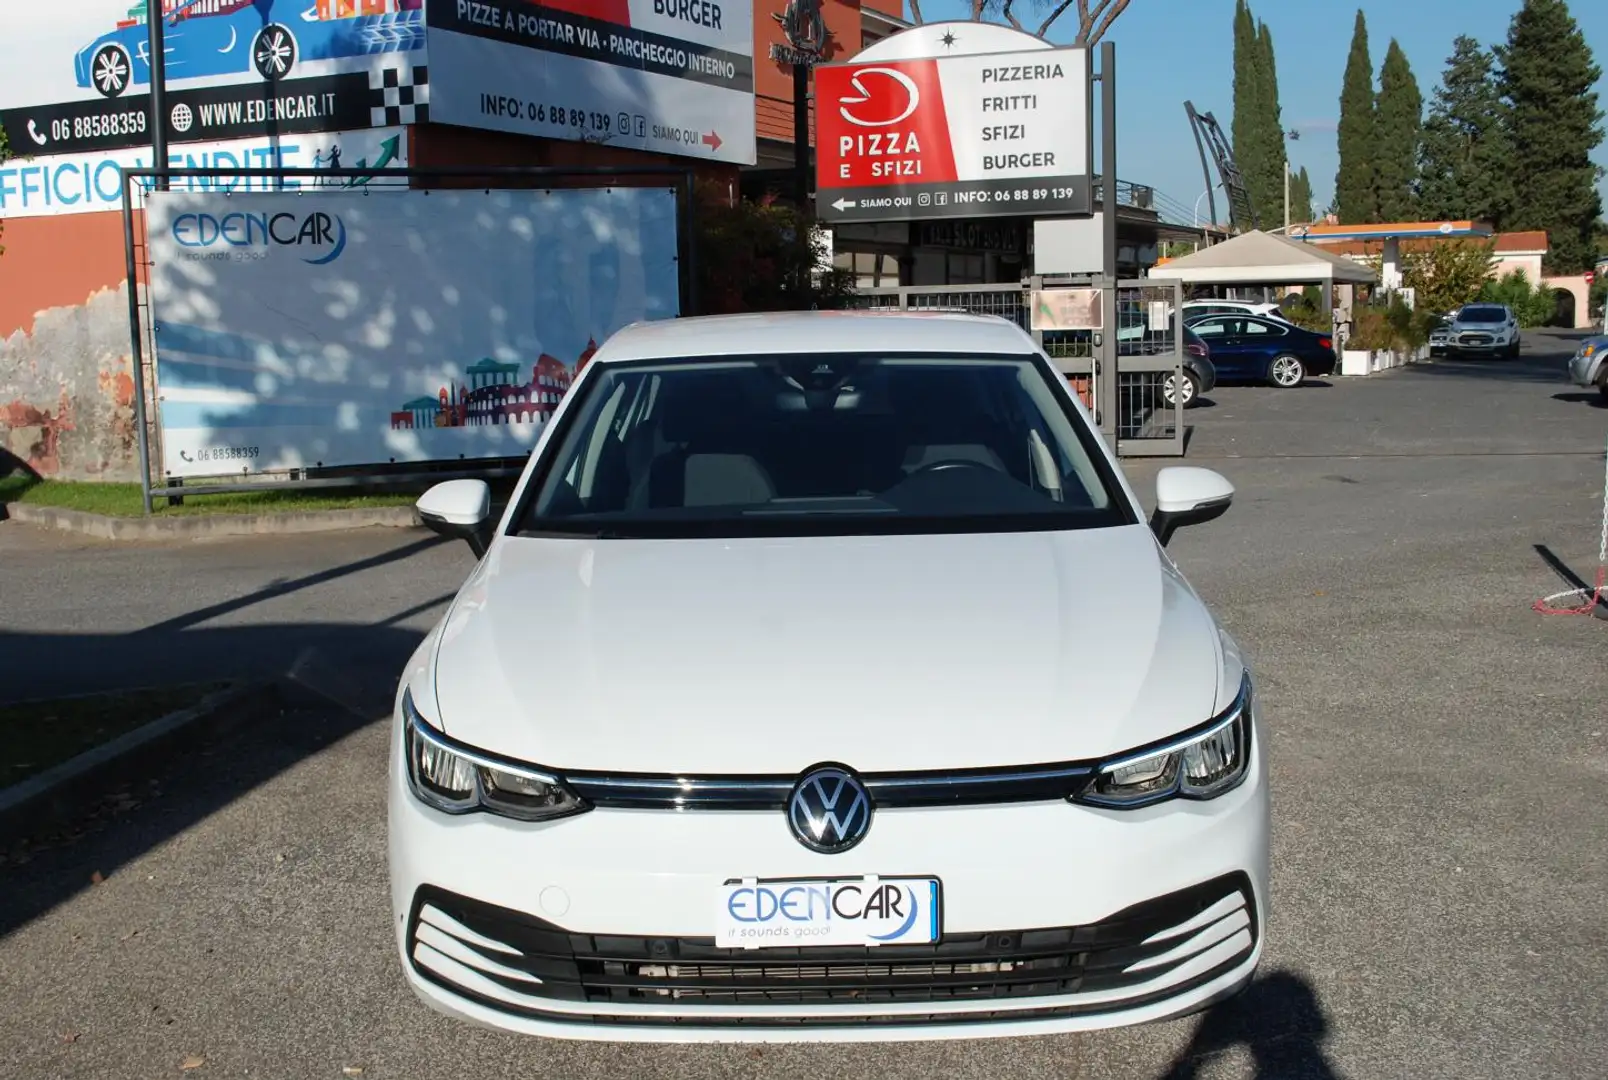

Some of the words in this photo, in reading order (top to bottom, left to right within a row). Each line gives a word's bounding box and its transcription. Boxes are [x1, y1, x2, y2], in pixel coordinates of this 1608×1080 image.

[653, 0, 722, 31] BURGER
[457, 0, 500, 28] PIZZE
[504, 10, 515, 32] A
[518, 13, 574, 44] PORTAR
[577, 26, 600, 50] VIA
[609, 34, 686, 68] PARCHEGGIO
[688, 52, 735, 79] INTERNO
[982, 64, 1064, 83] PIZZERIA
[982, 95, 1038, 112] FRITTI
[52, 118, 70, 141] 06
[74, 110, 146, 138] 88588359
[199, 93, 336, 127] WWW.EDENCAR.IT
[480, 93, 524, 119] INFO:
[528, 105, 545, 123] 06
[550, 107, 566, 126] 88
[570, 109, 585, 128] 89
[590, 111, 611, 132] 139
[652, 124, 681, 143] SIAMO
[683, 130, 699, 145] QUI
[982, 124, 1026, 141] SFIZI
[839, 132, 921, 157] PIZZA
[840, 164, 851, 178] E
[871, 159, 921, 177] SFIZI
[982, 151, 1056, 170] BURGER
[860, 198, 892, 208] SIAMO
[894, 196, 912, 207] QUI
[954, 191, 992, 203] INFO:
[994, 191, 1011, 202] 06
[1014, 189, 1030, 201] 88
[1033, 188, 1048, 200] 89
[1052, 188, 1074, 199] 139
[172, 212, 335, 247] EDENCAR
[197, 450, 210, 461] 06
[213, 446, 259, 460] 88588359
[727, 884, 905, 923] EDENCAR
[740, 926, 789, 938] sounds
